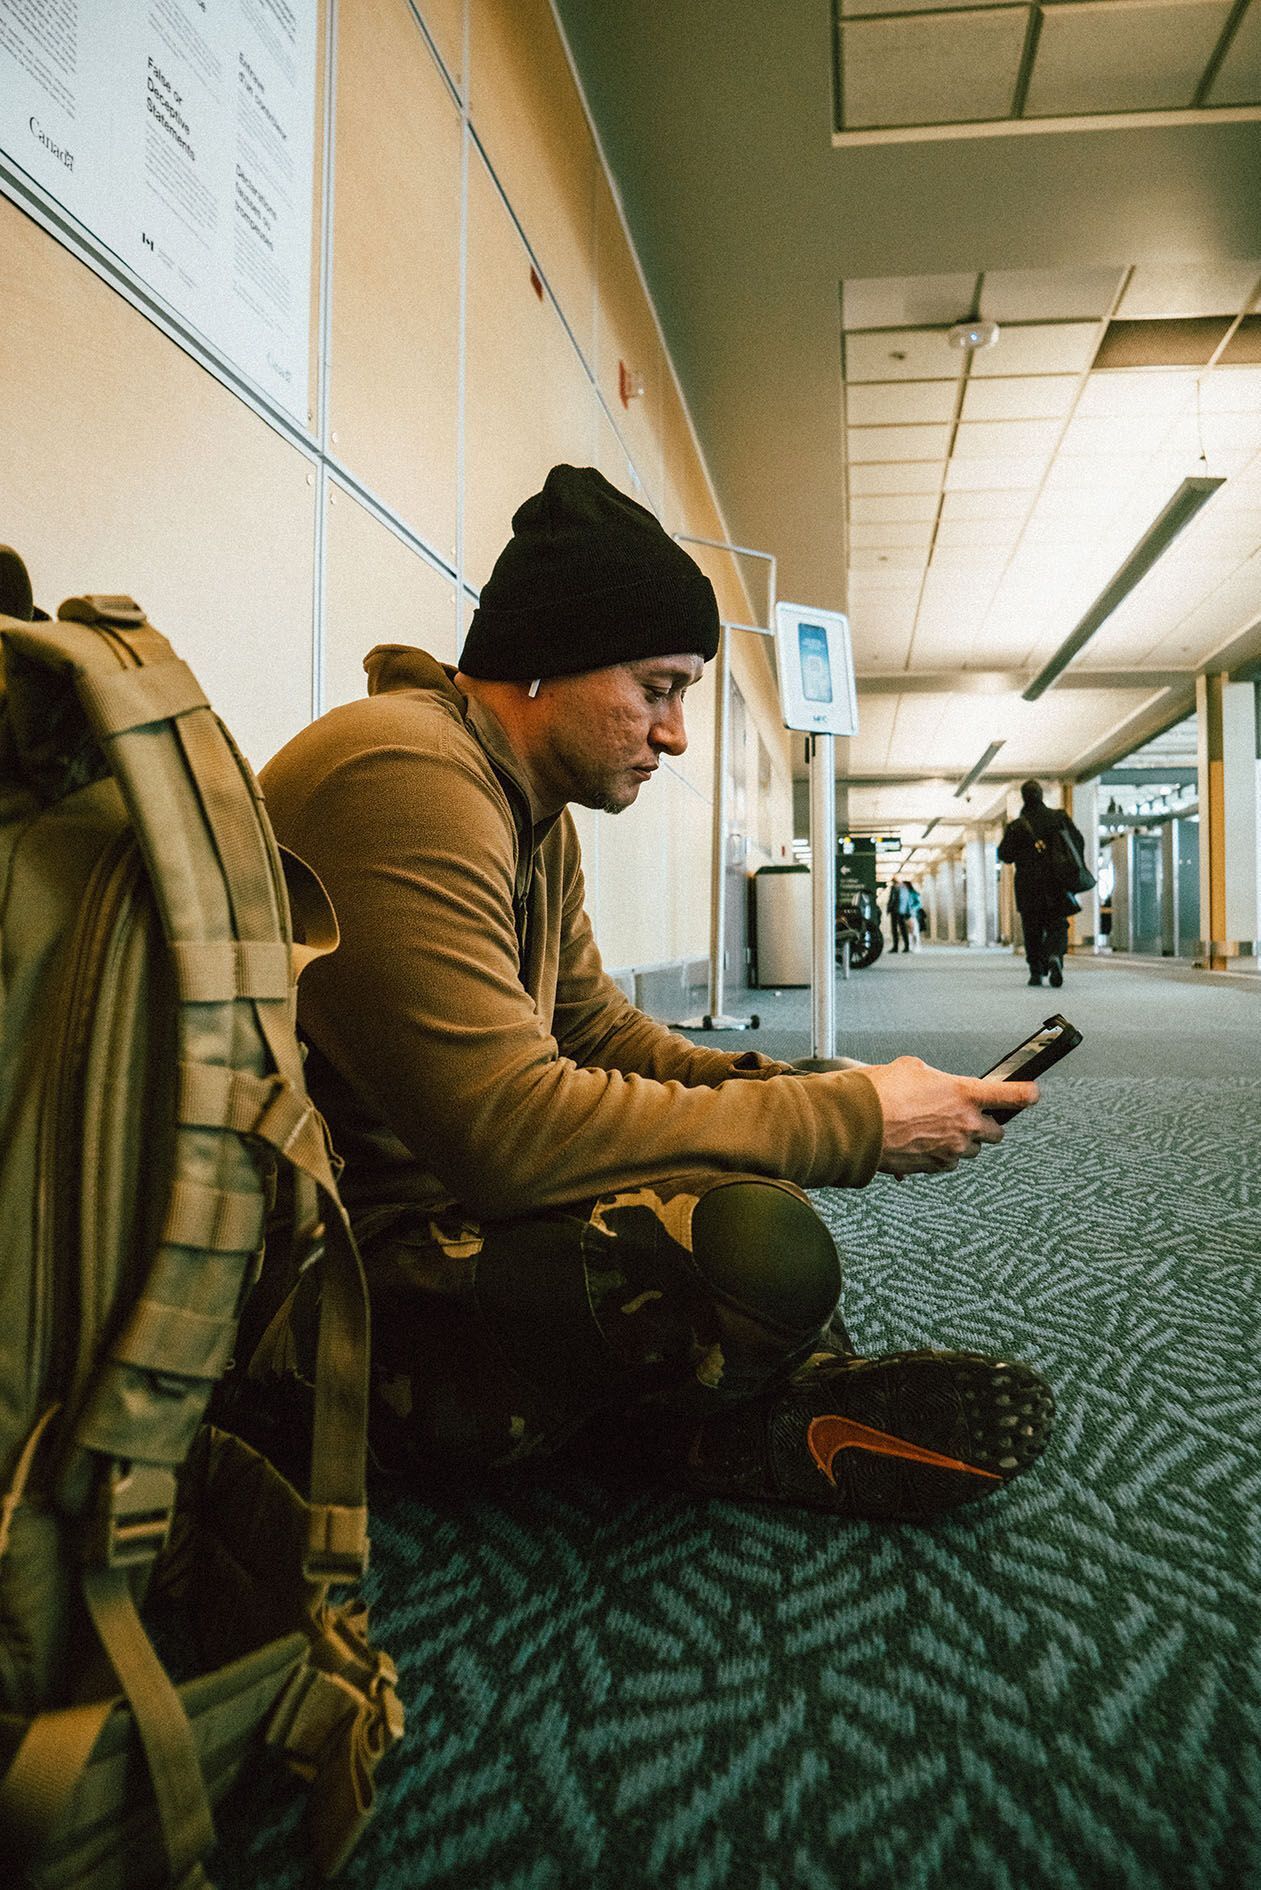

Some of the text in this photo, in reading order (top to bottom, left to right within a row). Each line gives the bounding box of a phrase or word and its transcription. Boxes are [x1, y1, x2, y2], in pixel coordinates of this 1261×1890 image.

[147, 76, 190, 135] Deceptive
[148, 56, 184, 105] False or
[29, 116, 74, 172] Canada
[146, 97, 196, 162] Statements
